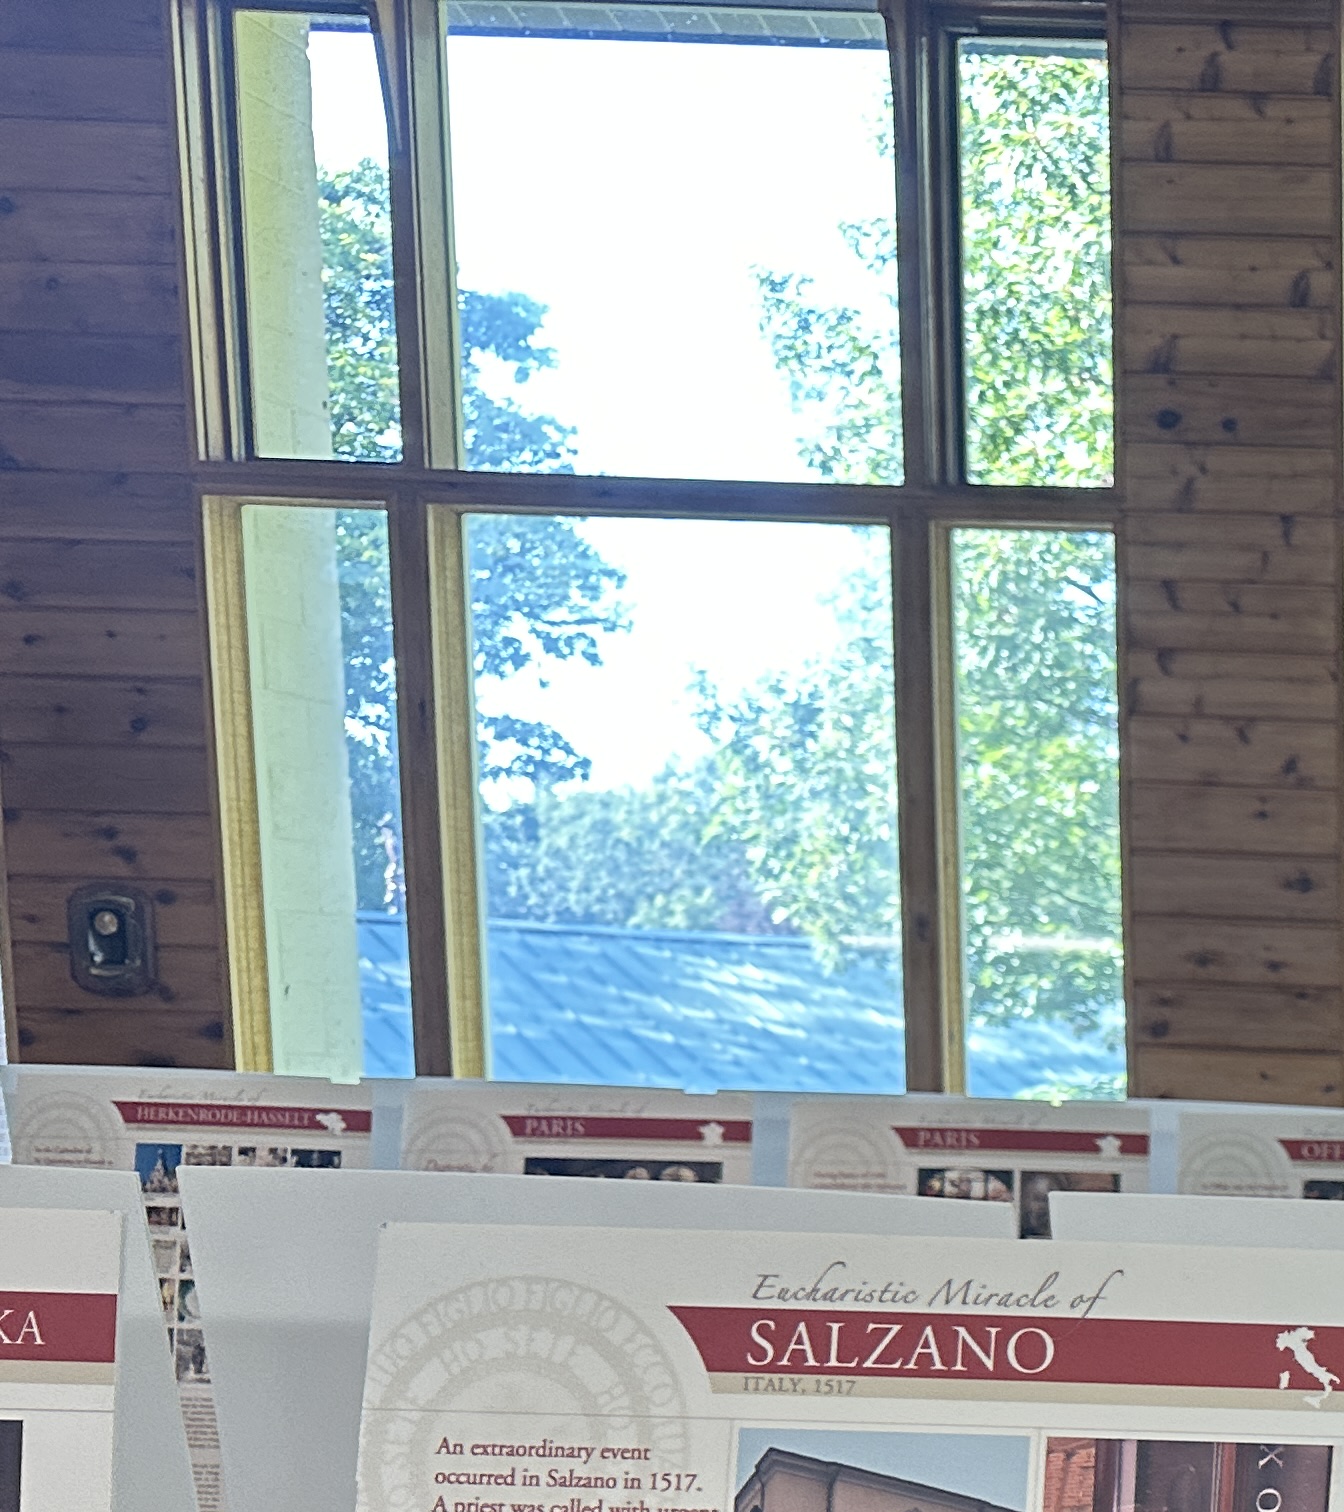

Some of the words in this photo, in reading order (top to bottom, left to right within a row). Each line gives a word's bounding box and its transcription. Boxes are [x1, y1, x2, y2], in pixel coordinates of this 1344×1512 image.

[136, 1105, 312, 1127] HERKENRODE-HASSELT
[524, 1118, 586, 1136] PARIS
[917, 1129, 980, 1147] PARIS
[751, 1261, 919, 1306] Eucharistic
[926, 1270, 1060, 1310] Miracle
[1069, 1269, 1125, 1320] of
[746, 1319, 1056, 1374] SALZANO
[743, 1375, 807, 1395] ITALY,
[814, 1377, 857, 1396] 1517
[435, 1437, 465, 1455] An
[470, 1439, 596, 1464] extraordinary
[600, 1447, 651, 1460] event
[1258, 1445, 1284, 1470] X
[434, 1467, 516, 1486] occurred
[521, 1468, 540, 1487] in
[546, 1469, 617, 1489] Salzano
[623, 1471, 642, 1490] in
[649, 1473, 702, 1492] 1517.
